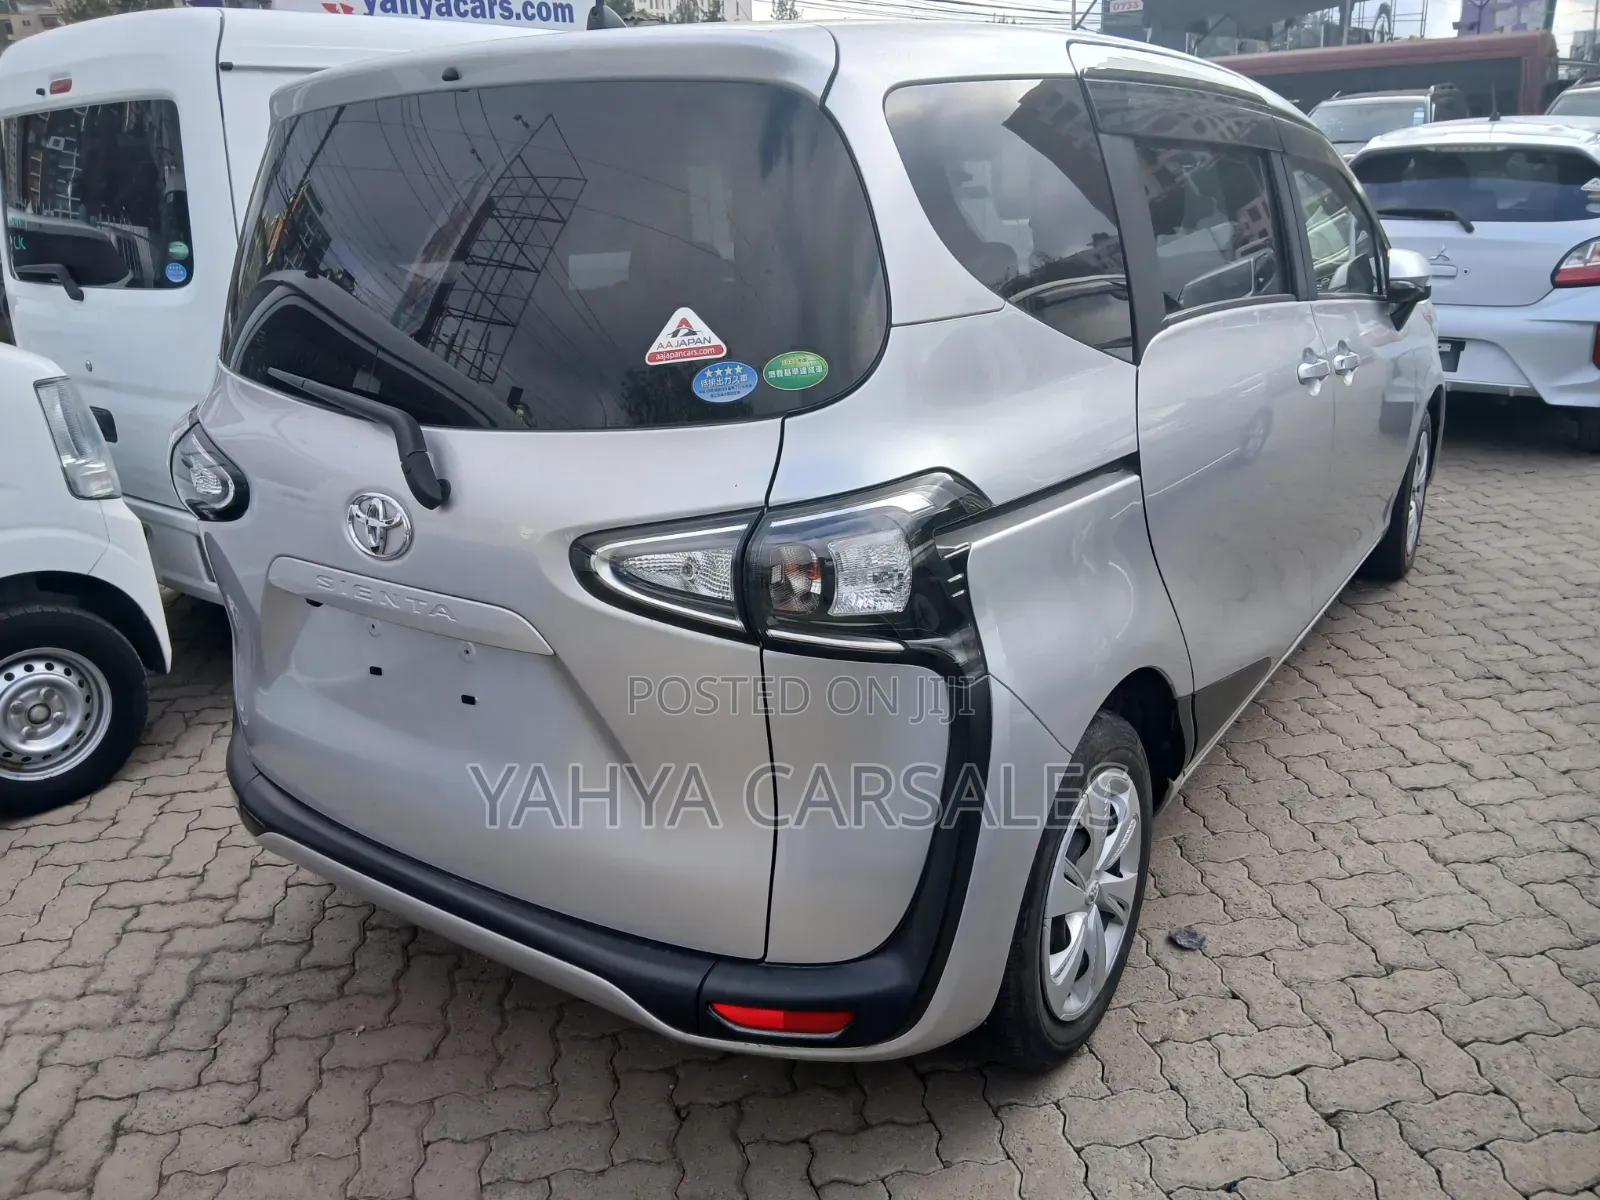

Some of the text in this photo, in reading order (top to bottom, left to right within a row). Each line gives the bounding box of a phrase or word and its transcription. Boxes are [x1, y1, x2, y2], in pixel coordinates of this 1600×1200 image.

[674, 336, 712, 348] JAPAN
[655, 347, 715, 361] aajapancars.com
[316, 574, 458, 622] SIENTA
